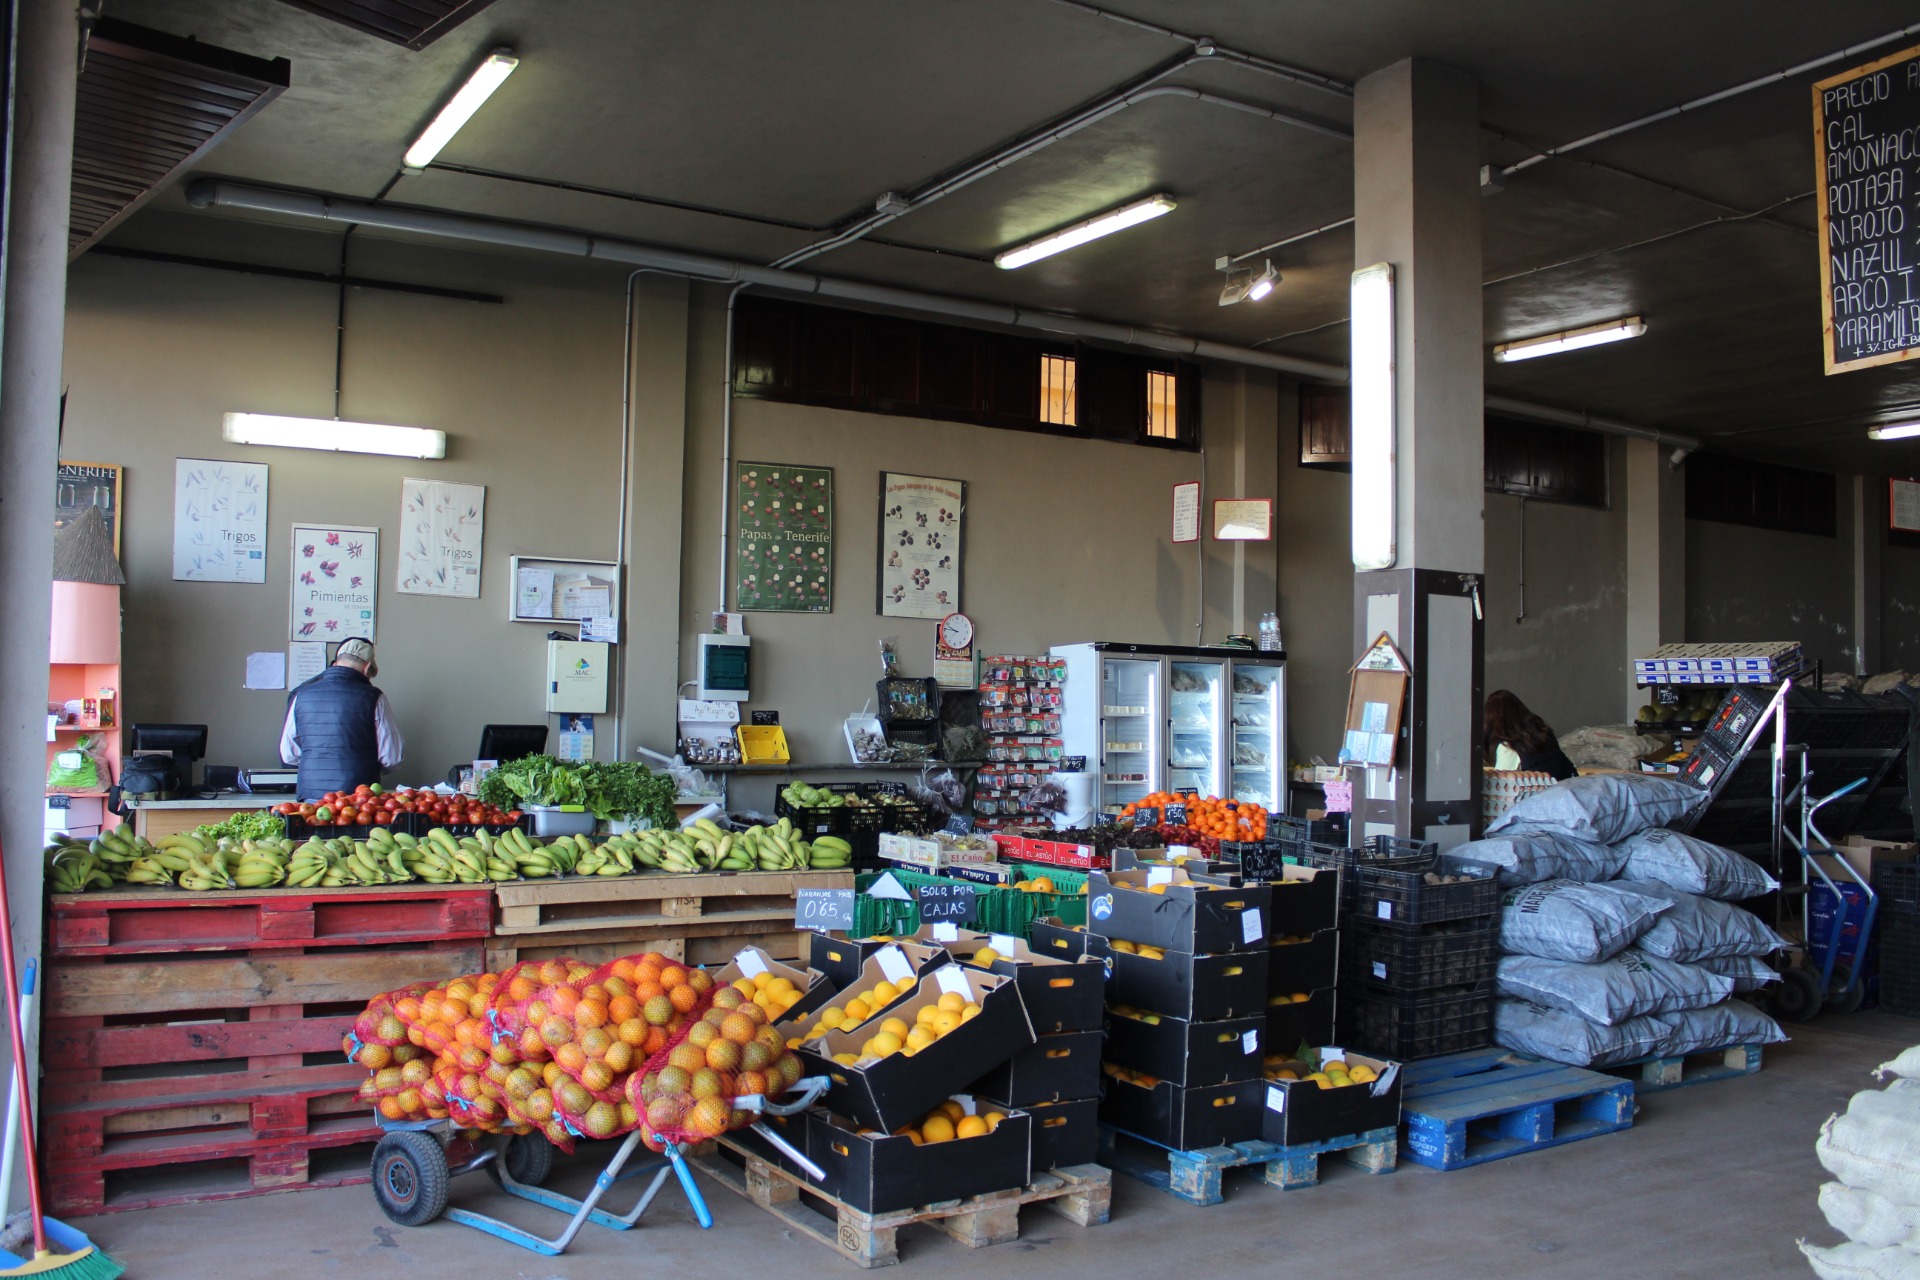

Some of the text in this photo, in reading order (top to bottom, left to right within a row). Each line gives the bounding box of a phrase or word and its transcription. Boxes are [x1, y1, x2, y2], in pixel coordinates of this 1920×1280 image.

[1824, 72, 1890, 116] PRECIO
[1827, 112, 1875, 150] CAL
[1829, 168, 1904, 216] POTASA
[221, 529, 257, 544] Trigos
[740, 528, 773, 541] Papas
[784, 530, 830, 543] Tenerife
[441, 546, 473, 560] Trigos
[311, 590, 369, 603] Pimientas
[951, 853, 984, 862] El Caño
[799, 890, 832, 898] NARANJAS
[953, 885, 975, 896] POR
[923, 902, 966, 917] CAJAS
[1520, 891, 1550, 914] MADE
